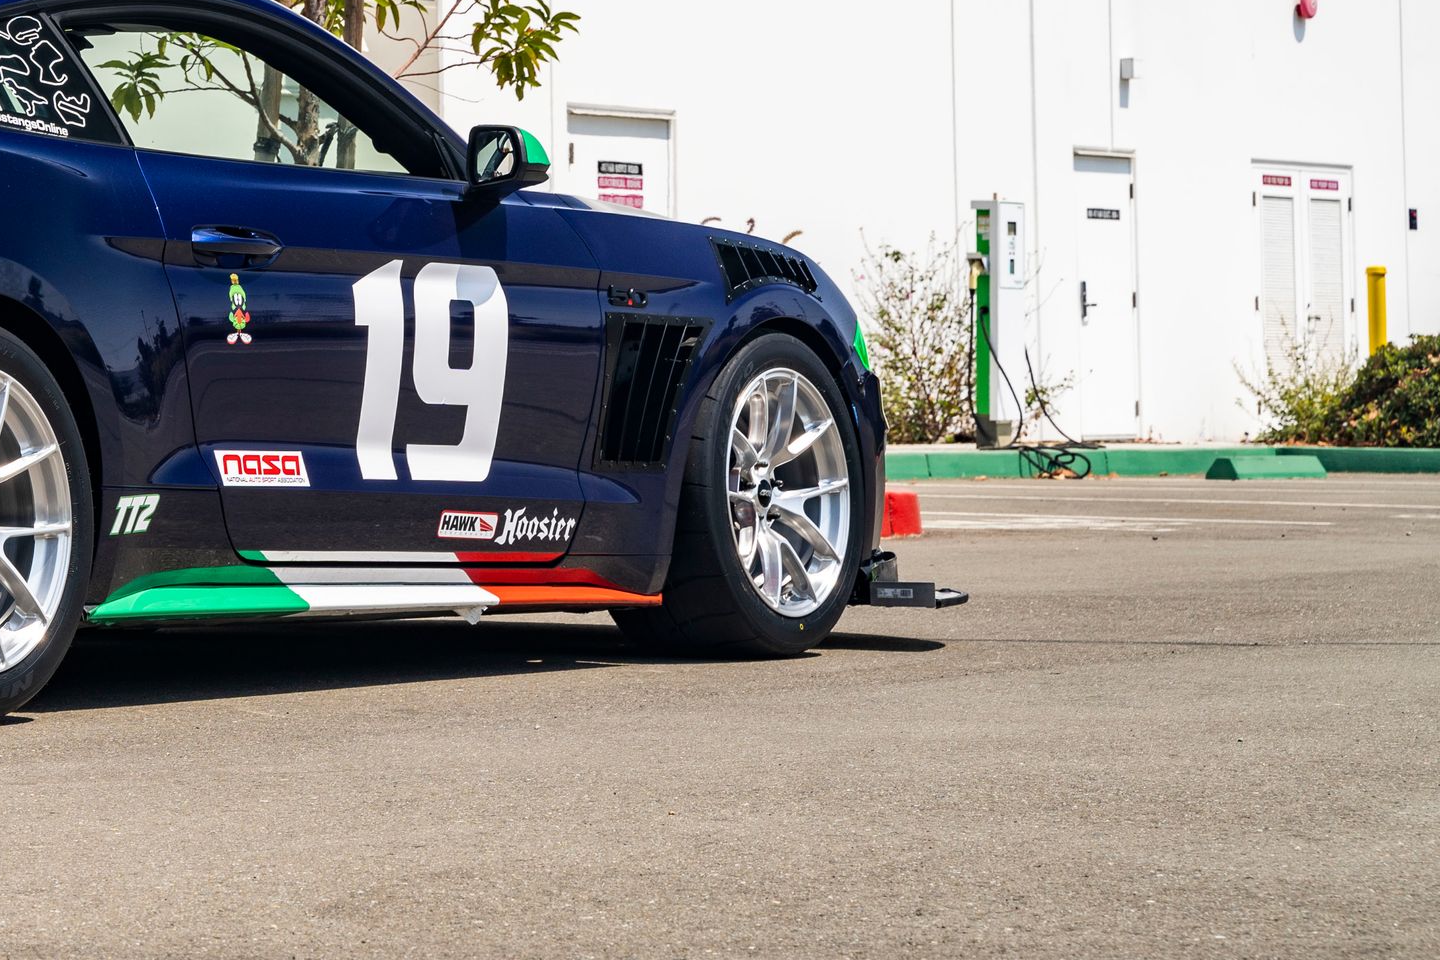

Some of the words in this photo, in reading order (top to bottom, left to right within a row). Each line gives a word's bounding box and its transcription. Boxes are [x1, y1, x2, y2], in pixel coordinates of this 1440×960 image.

[352, 259, 509, 482] 19
[222, 454, 301, 476] nasa
[109, 494, 161, 536] TT2
[441, 514, 479, 531] HAWK
[494, 506, 576, 545] Hoosier
